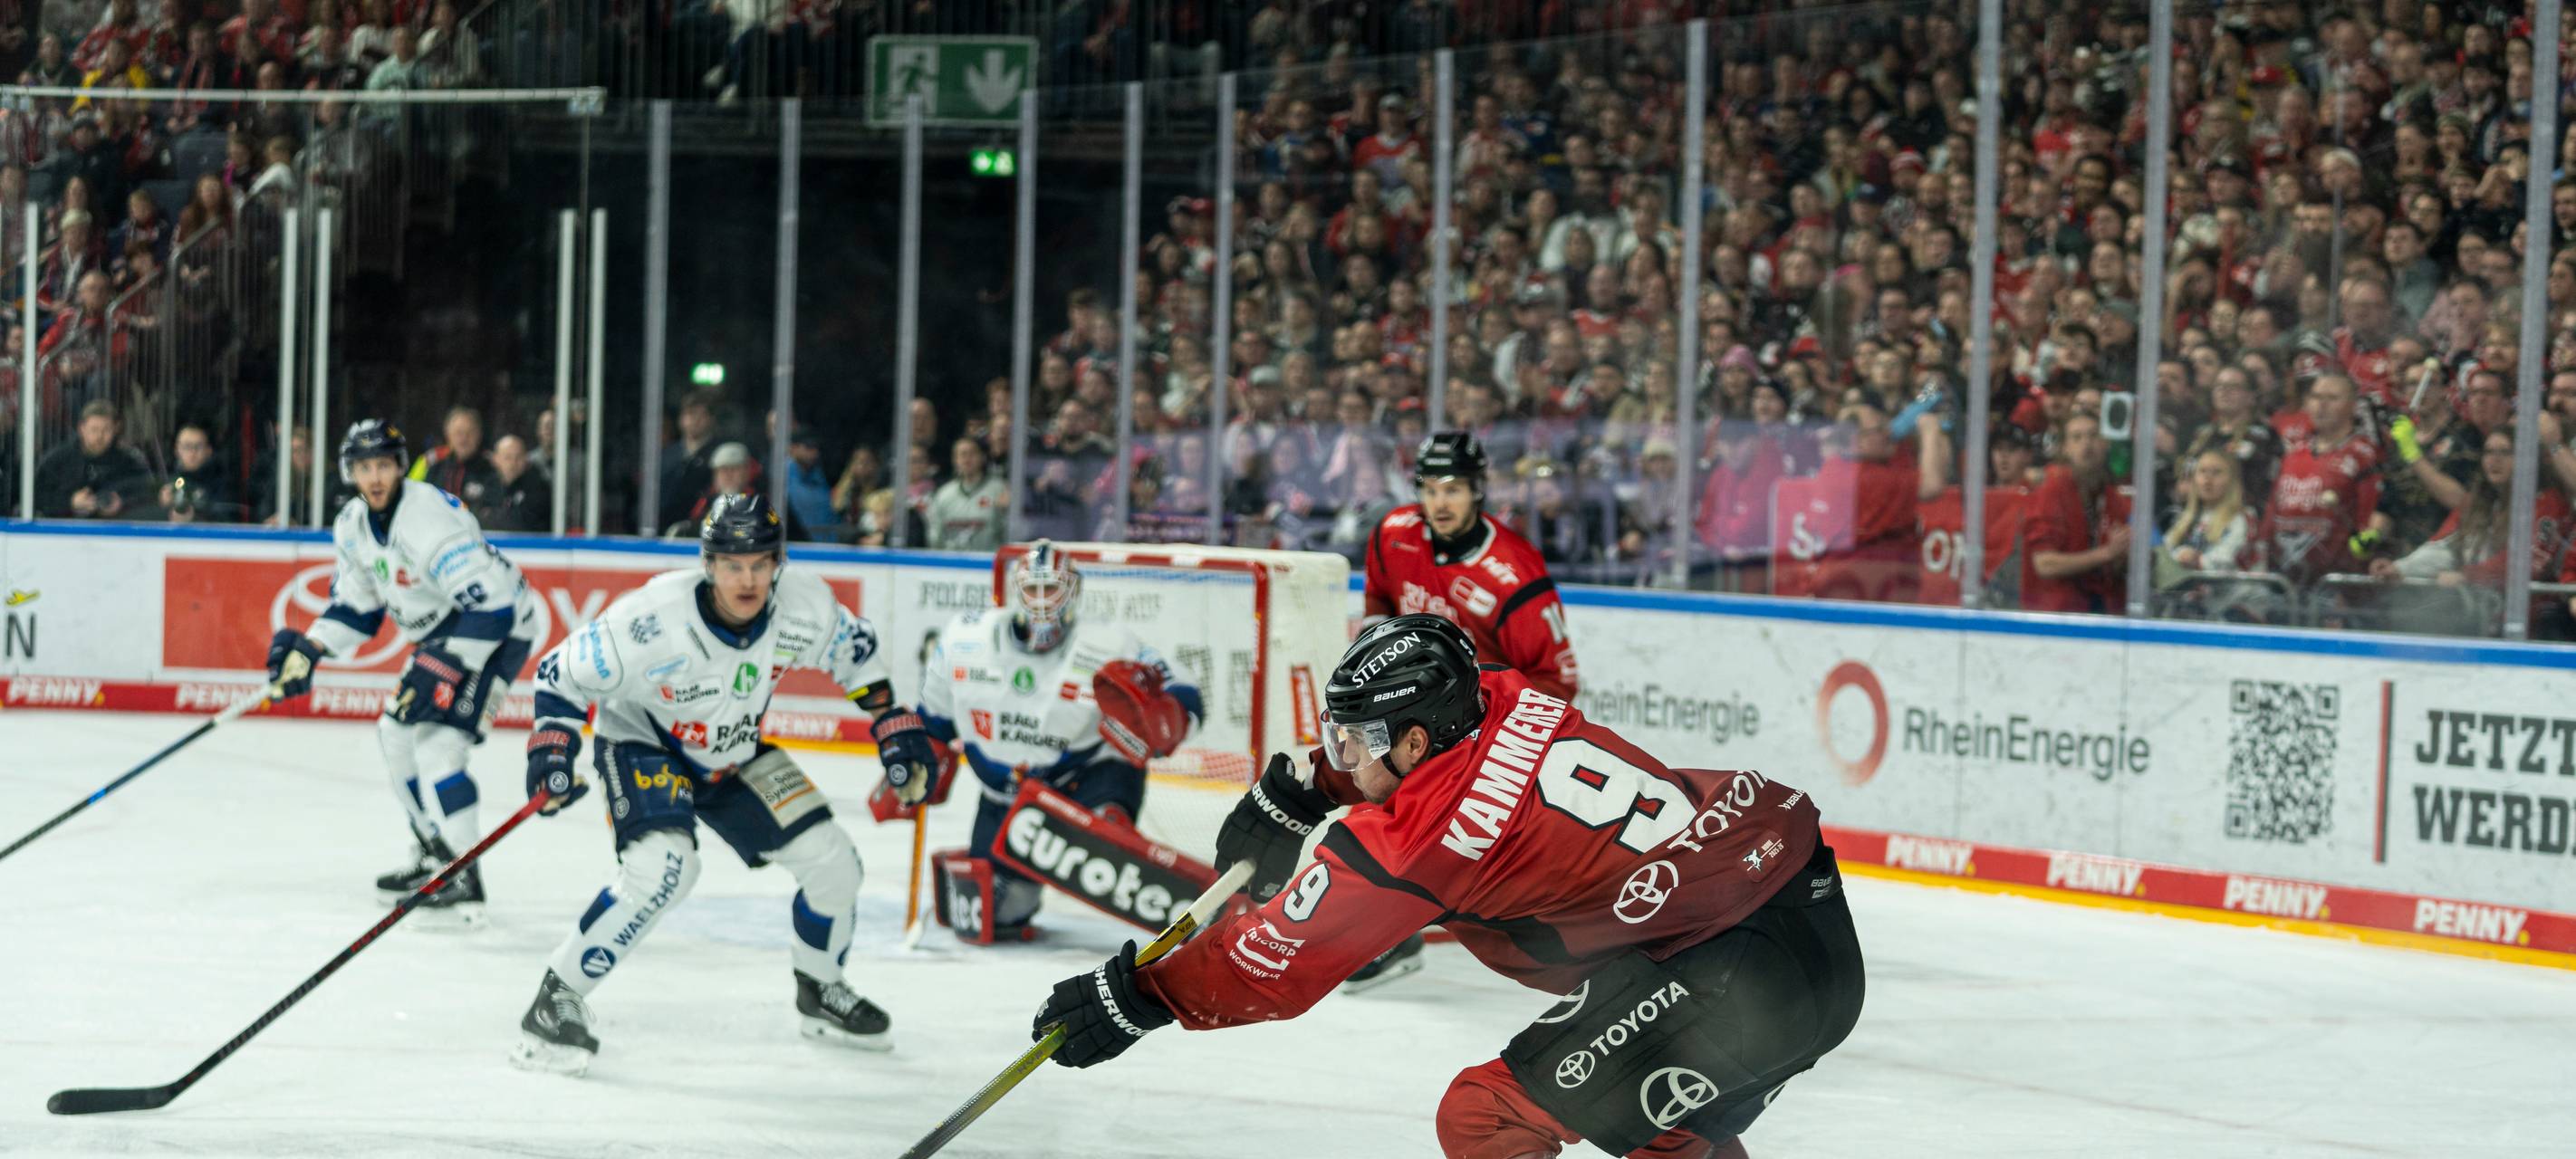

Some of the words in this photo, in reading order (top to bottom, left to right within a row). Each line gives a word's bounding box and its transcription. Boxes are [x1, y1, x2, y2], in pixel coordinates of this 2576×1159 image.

[5, 611, 36, 659] N
[1351, 632, 1421, 688] STETSON
[716, 710, 763, 741] RAA
[1580, 681, 1761, 745] heinEnergie
[1903, 707, 2150, 782] RheinEnergie
[2415, 709, 2576, 777] JETZT
[1440, 687, 1568, 862] KAMMERER
[1534, 736, 1700, 857] 9
[1667, 770, 1768, 853] TOYOT
[2413, 784, 2576, 858] WERD
[613, 850, 684, 946] WAELZHOLZ
[1283, 862, 1331, 922] 9
[1228, 949, 1282, 980] WORKWEAR
[1245, 926, 1297, 957] TRICORP
[1590, 981, 1690, 1057] TOYOTA
